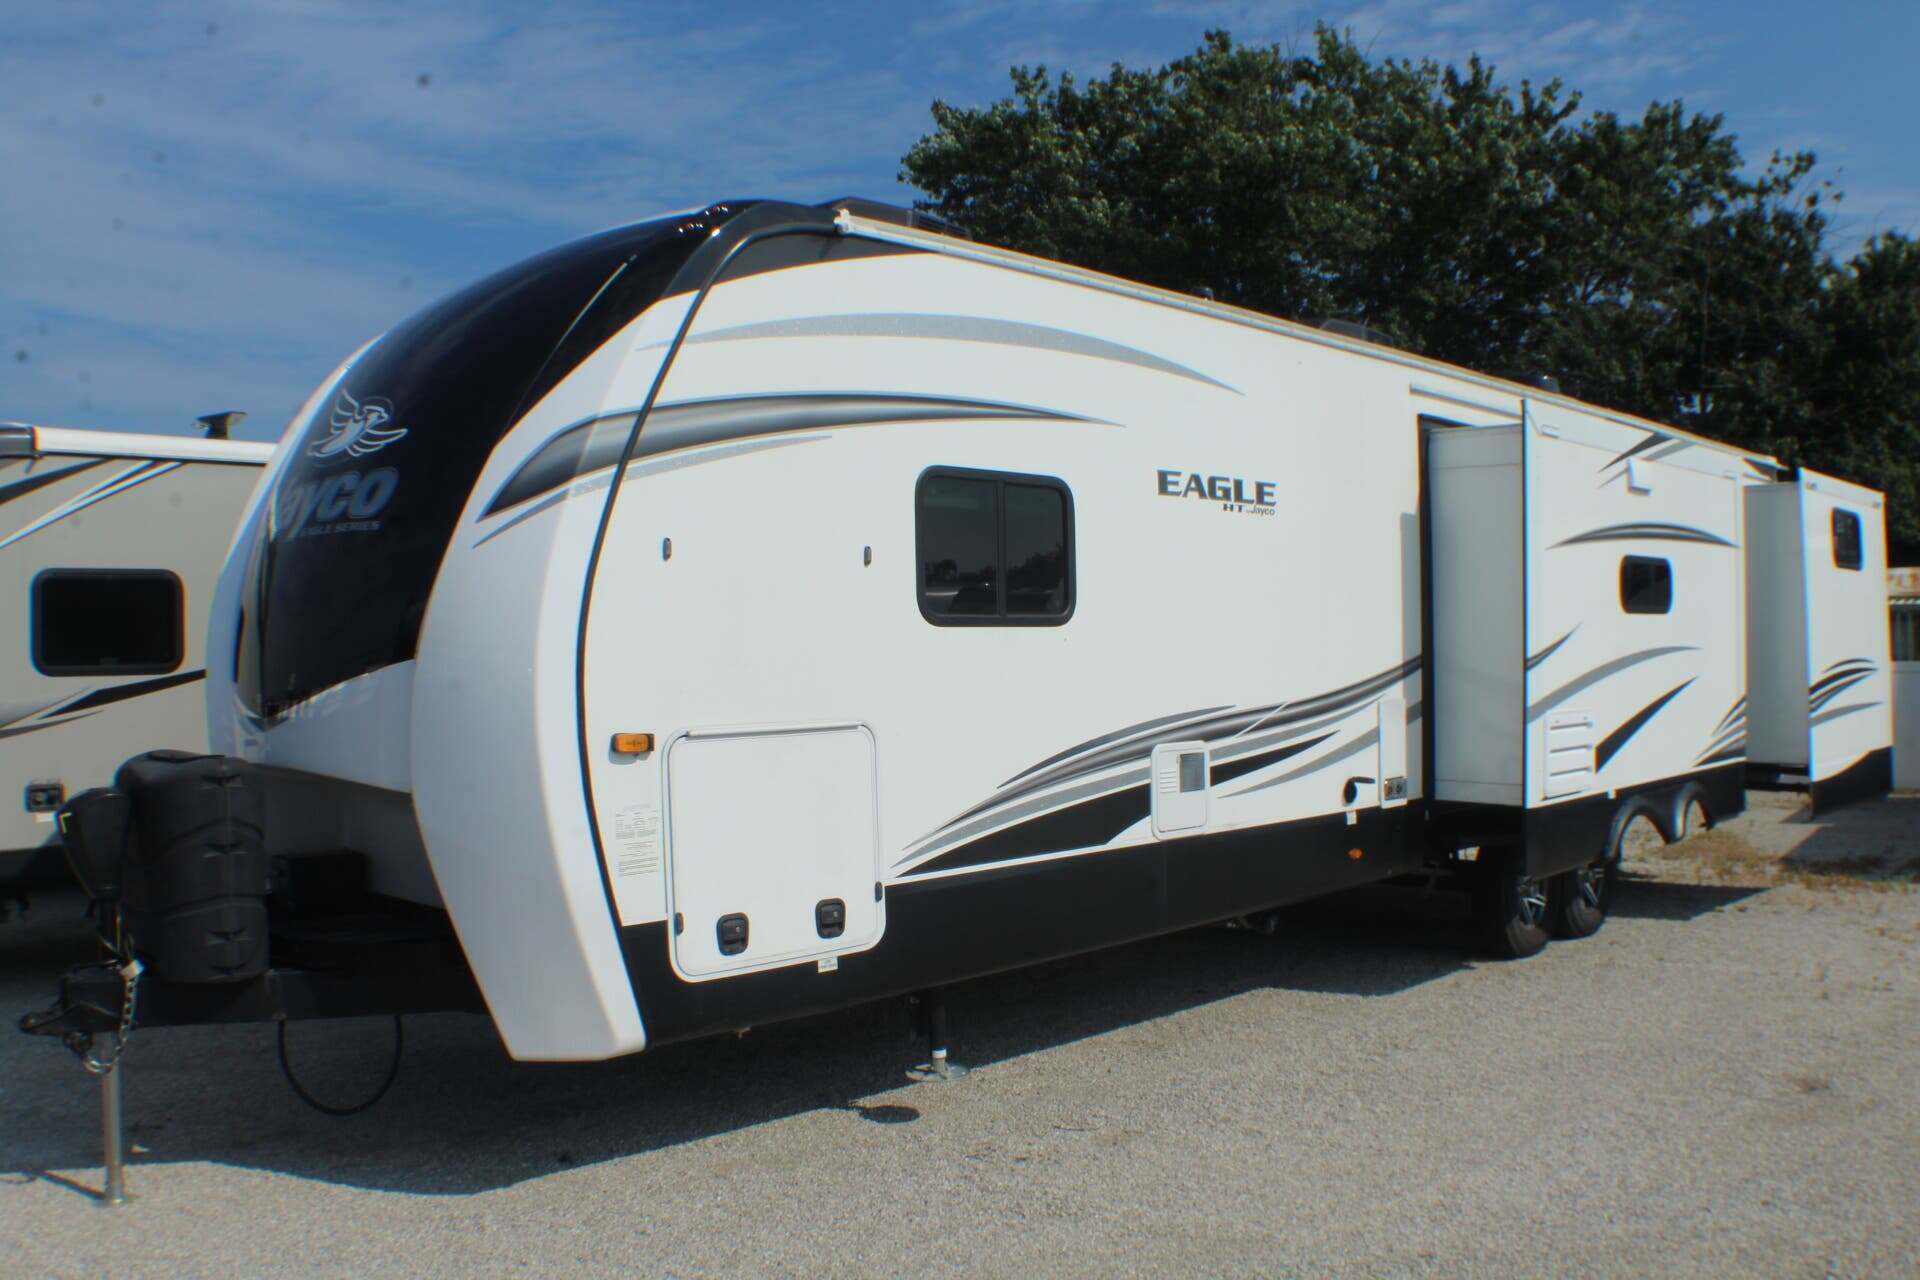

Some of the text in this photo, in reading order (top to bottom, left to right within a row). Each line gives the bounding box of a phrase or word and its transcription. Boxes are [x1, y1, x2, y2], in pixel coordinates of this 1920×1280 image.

[1157, 469, 1277, 507] EAGLE
[1223, 503, 1245, 512] HT
[1251, 504, 1276, 517] Jayco
